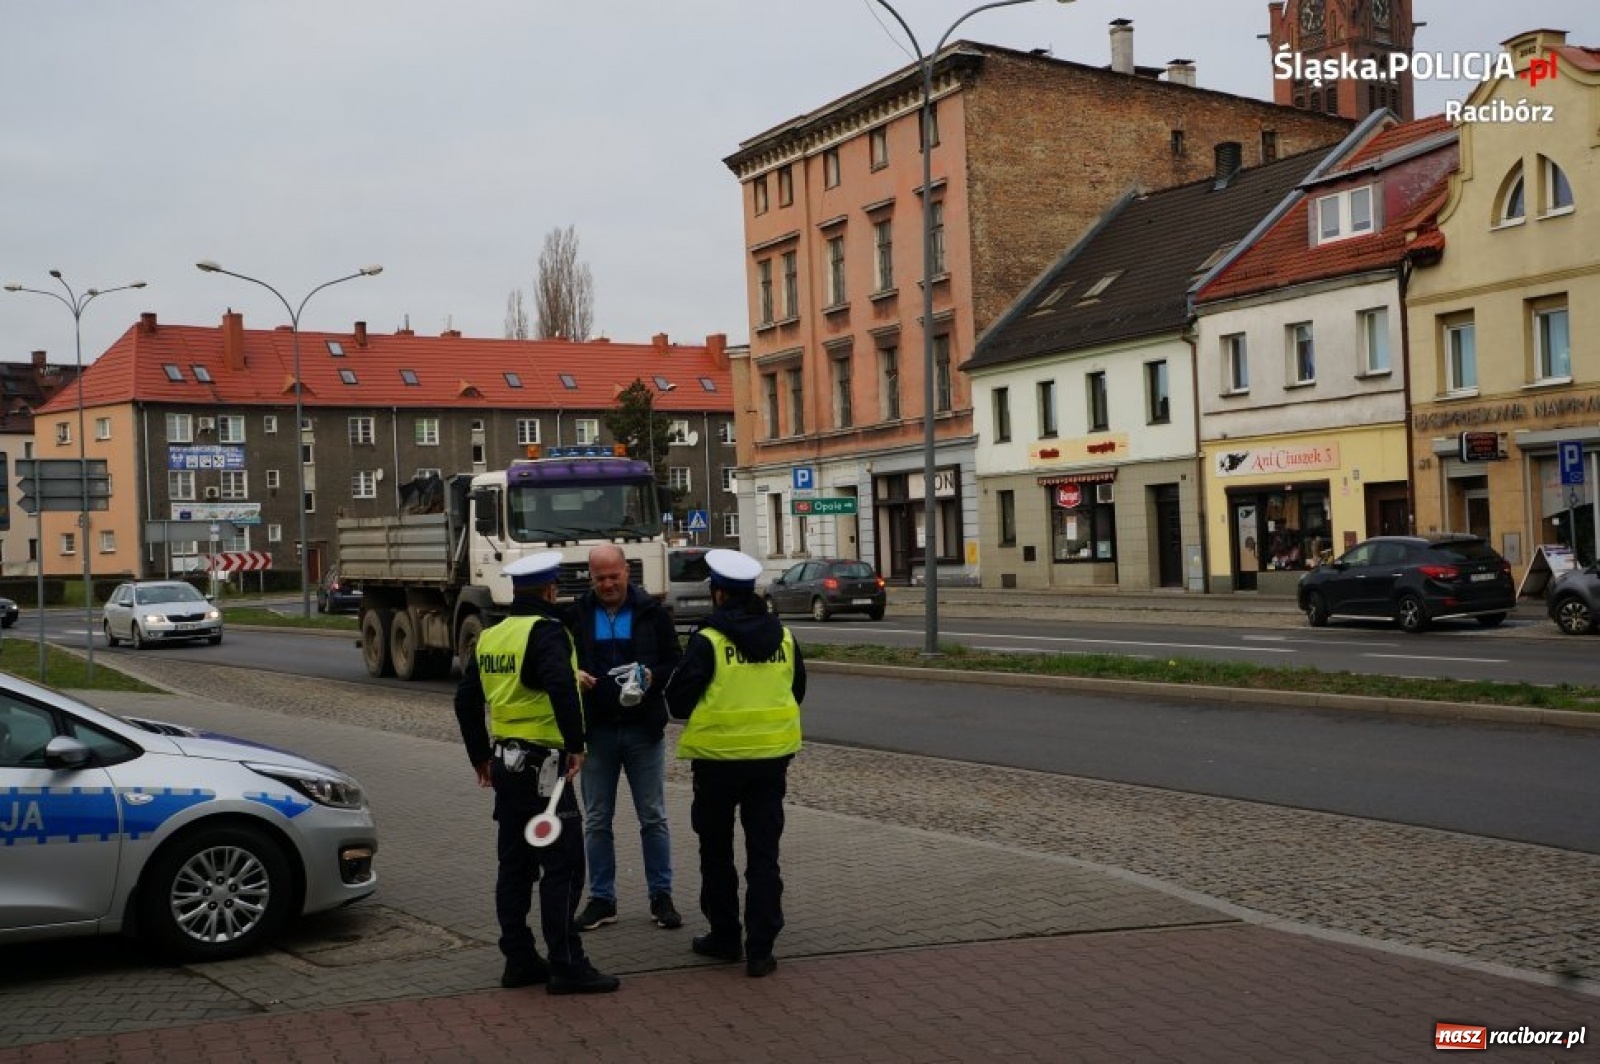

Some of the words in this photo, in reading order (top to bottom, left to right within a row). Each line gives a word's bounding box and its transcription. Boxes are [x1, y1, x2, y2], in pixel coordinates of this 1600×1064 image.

[1252, 452, 1274, 471] Ani
[1276, 449, 1321, 469] Ciuszek
[1564, 445, 1579, 472] P
[797, 469, 809, 487] P
[924, 473, 954, 490] ON
[814, 501, 842, 513] Opole
[479, 653, 515, 674] POLICJA
[725, 645, 787, 665] POJA
